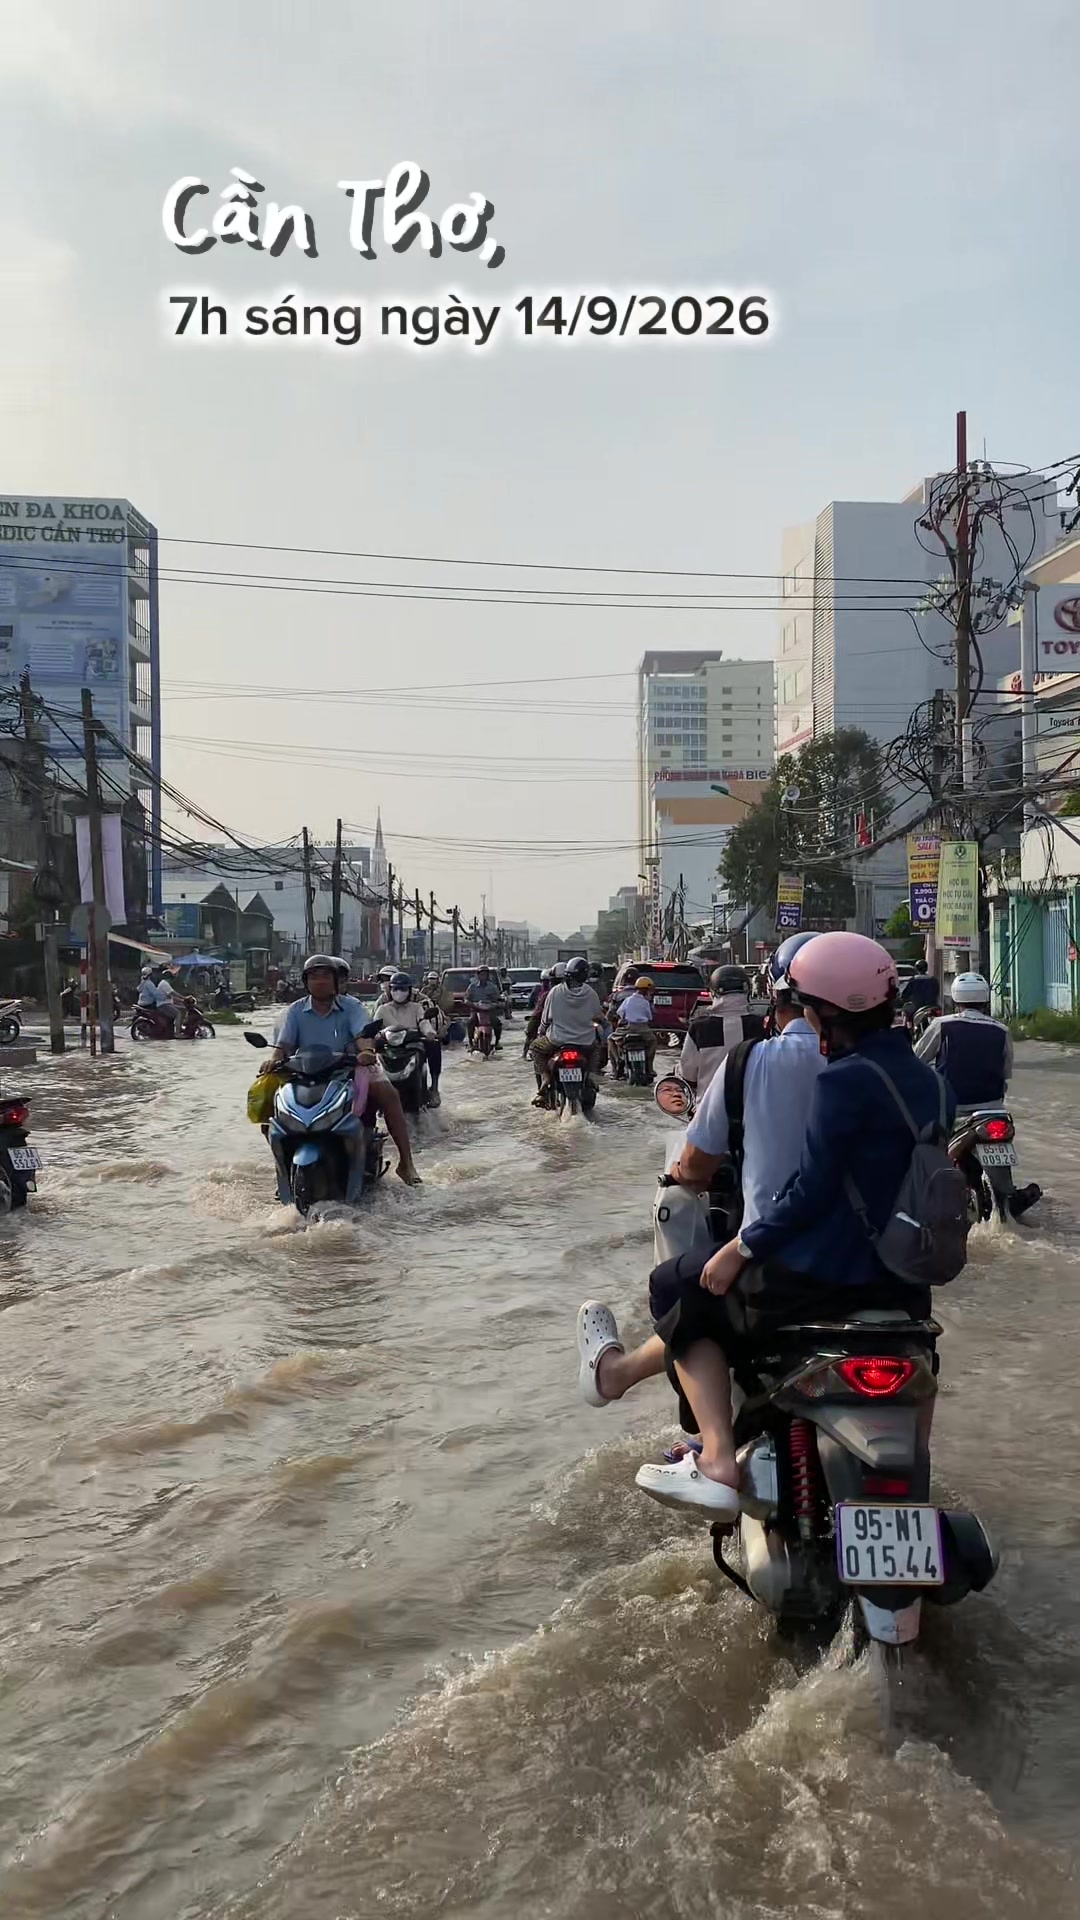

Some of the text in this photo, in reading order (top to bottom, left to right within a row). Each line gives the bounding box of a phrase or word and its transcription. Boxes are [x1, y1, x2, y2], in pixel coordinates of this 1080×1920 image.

[25, 502, 56, 518] ĐA
[63, 503, 125, 520] KHOA
[0, 526, 36, 541] DIC
[854, 1509, 922, 1541] 95-N1
[846, 1545, 937, 1578] 015.44
